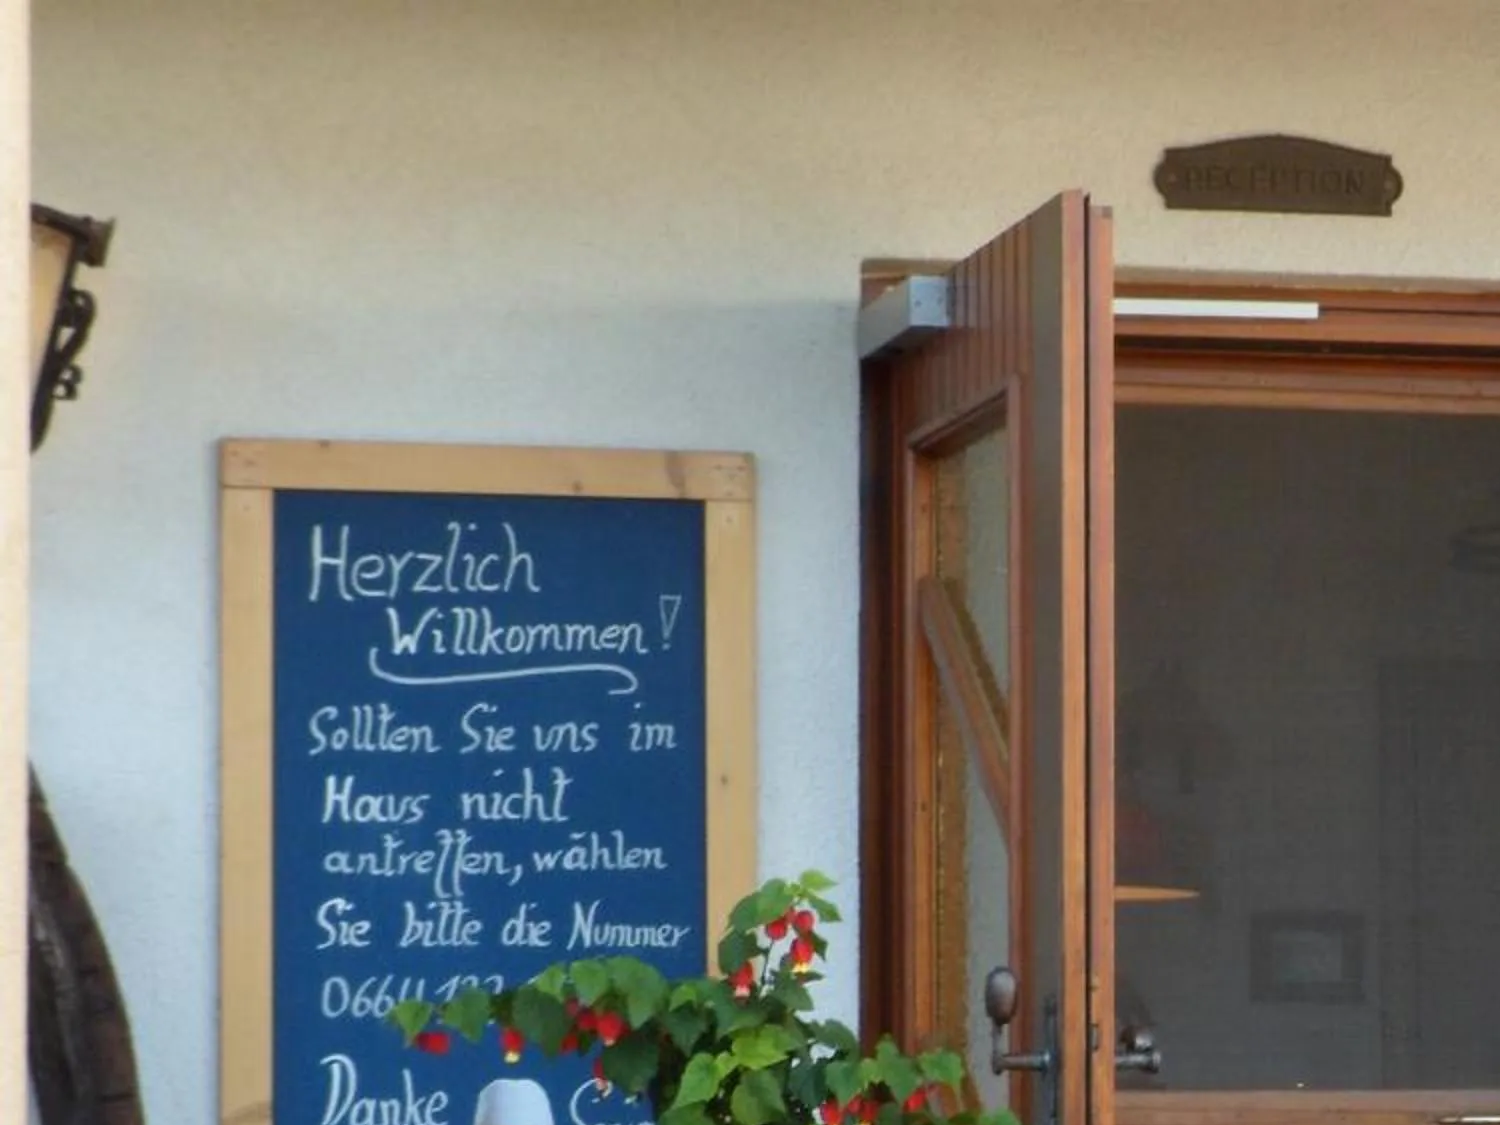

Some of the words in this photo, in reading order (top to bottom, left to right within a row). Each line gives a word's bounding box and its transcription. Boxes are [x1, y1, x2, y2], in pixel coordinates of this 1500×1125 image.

[308, 522, 541, 601] Herzlich
[308, 703, 441, 756] Sollten
[459, 702, 517, 755] Sie
[628, 703, 678, 752] im
[460, 766, 574, 822] nicht
[532, 830, 667, 875] wählen
[315, 897, 371, 950] Sie
[399, 899, 483, 948] bitte
[501, 901, 552, 948] die
